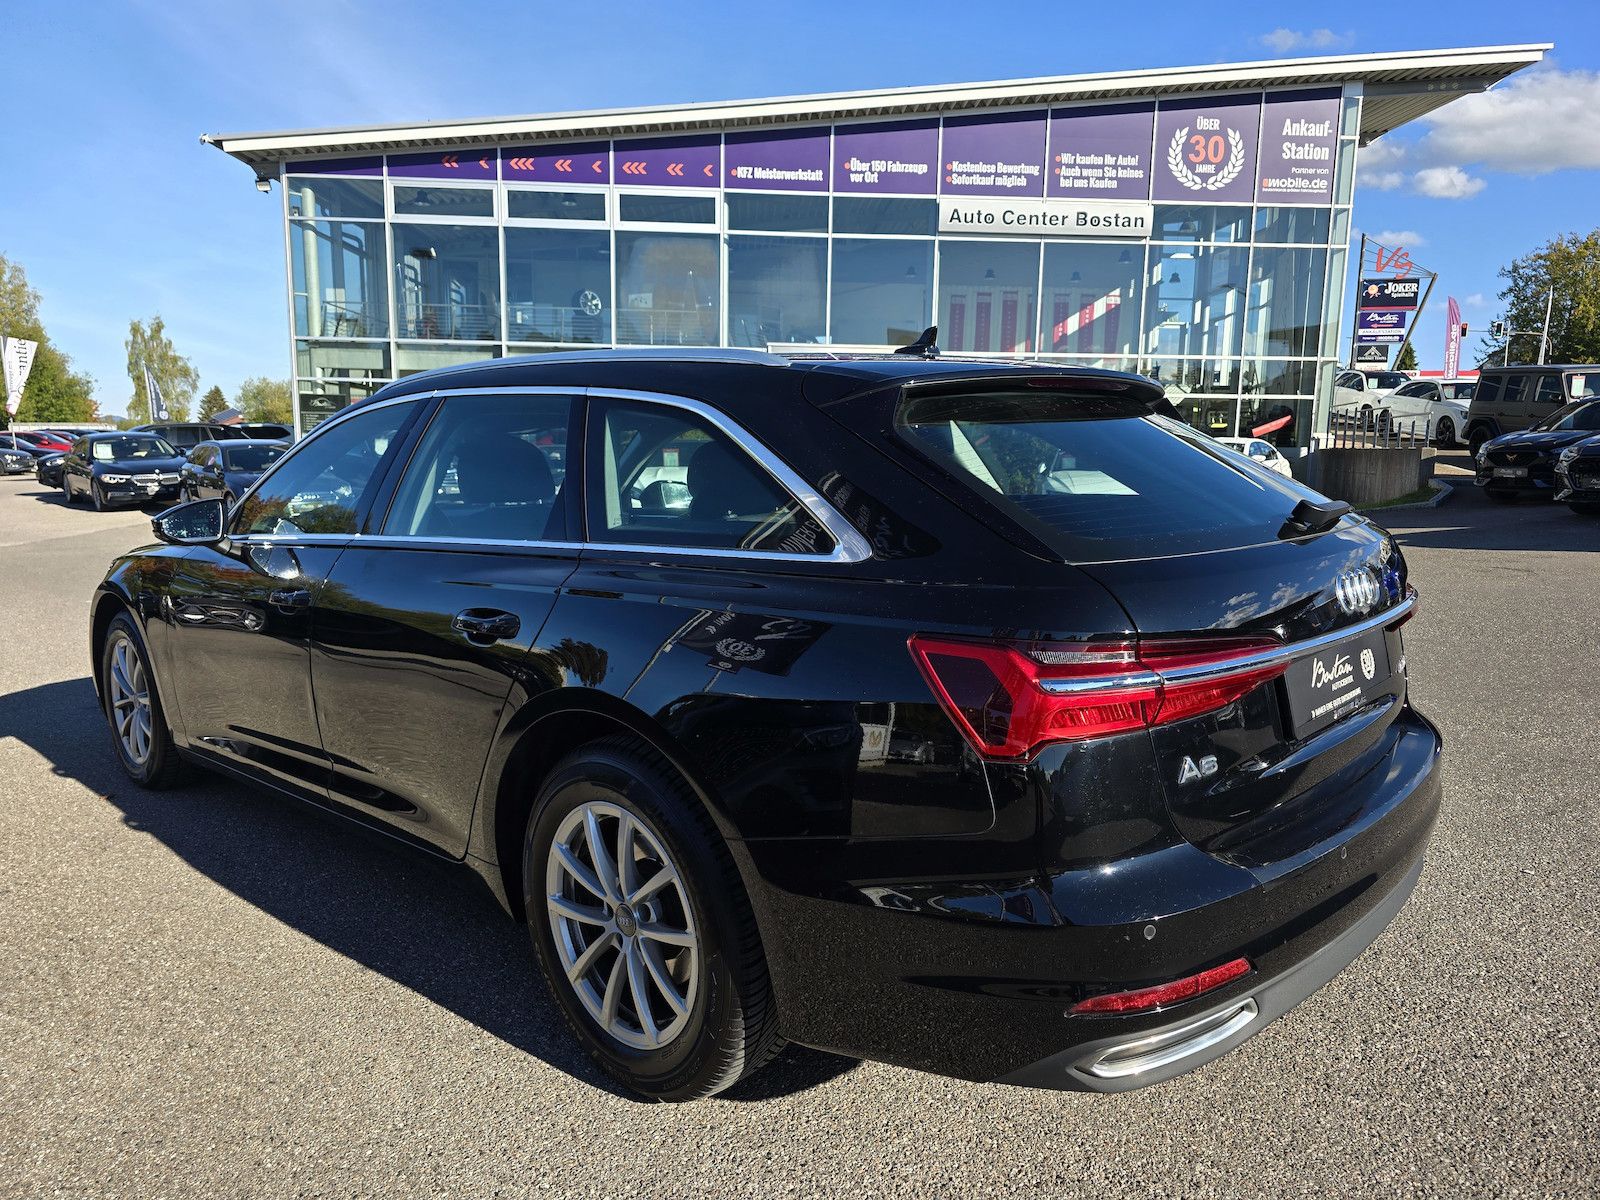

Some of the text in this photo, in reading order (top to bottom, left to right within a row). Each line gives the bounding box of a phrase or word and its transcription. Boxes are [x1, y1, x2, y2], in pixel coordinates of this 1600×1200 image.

[1196, 115, 1221, 130] ÜBER
[1282, 118, 1333, 137] Ankauf-
[1188, 134, 1226, 164] 30
[1281, 141, 1330, 161] Station
[850, 157, 928, 175] Über 150 Fahrzeuge
[1060, 152, 1139, 166] Wir kaufen Ihr Auto!
[736, 166, 824, 182] KFZ Meisterwerkstatt
[952, 160, 1040, 176] Kostenlose Bewertung
[1060, 165, 1144, 178] Auch wenn Sie keines
[1194, 163, 1217, 174] JAHRE
[1291, 166, 1317, 175] Partner
[850, 172, 879, 183] vor Ort
[951, 173, 1027, 188] Sofortkauf möglich
[1060, 177, 1118, 189] bei uns Kaufen
[1268, 177, 1328, 190] mobile.de
[949, 208, 1145, 228] Auto Center Bostan
[1384, 282, 1418, 294] JOKER
[1177, 754, 1219, 784] A6
